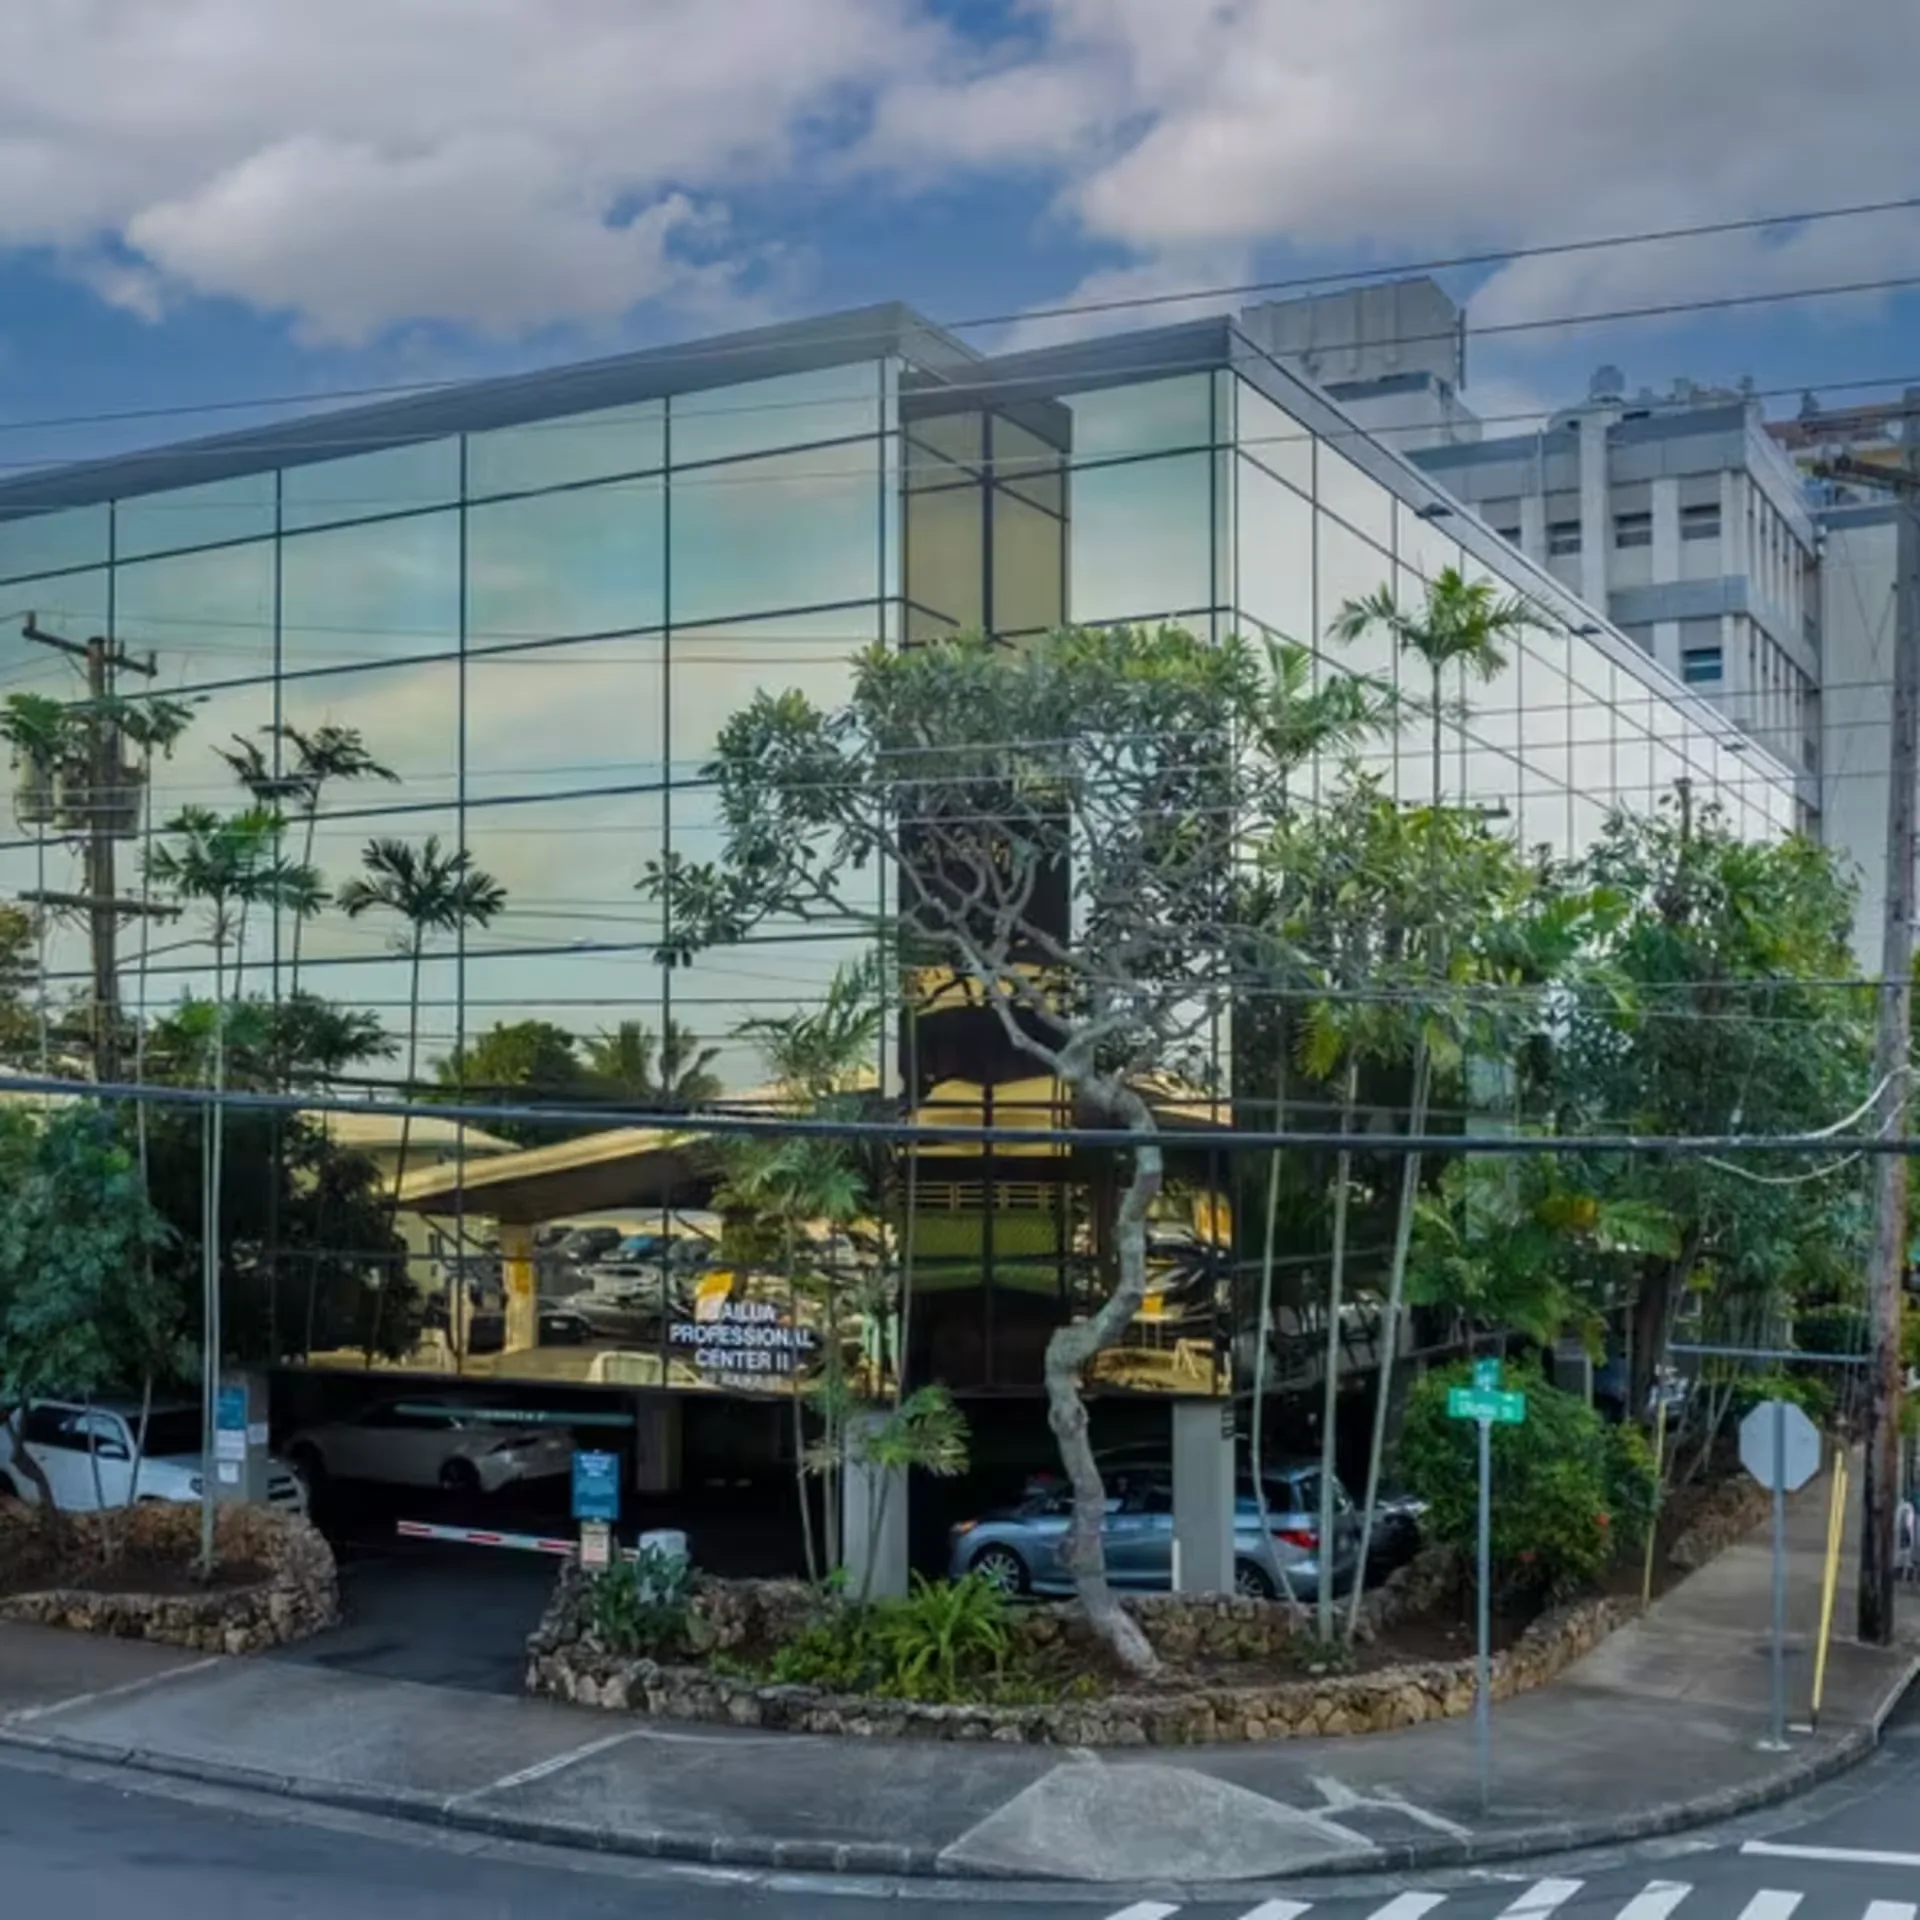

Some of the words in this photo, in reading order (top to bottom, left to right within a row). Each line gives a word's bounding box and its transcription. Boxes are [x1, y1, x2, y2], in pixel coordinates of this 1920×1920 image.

[708, 1302, 776, 1322] AILUA
[694, 1347, 772, 1371] CENTER
[776, 1353, 789, 1372] II
